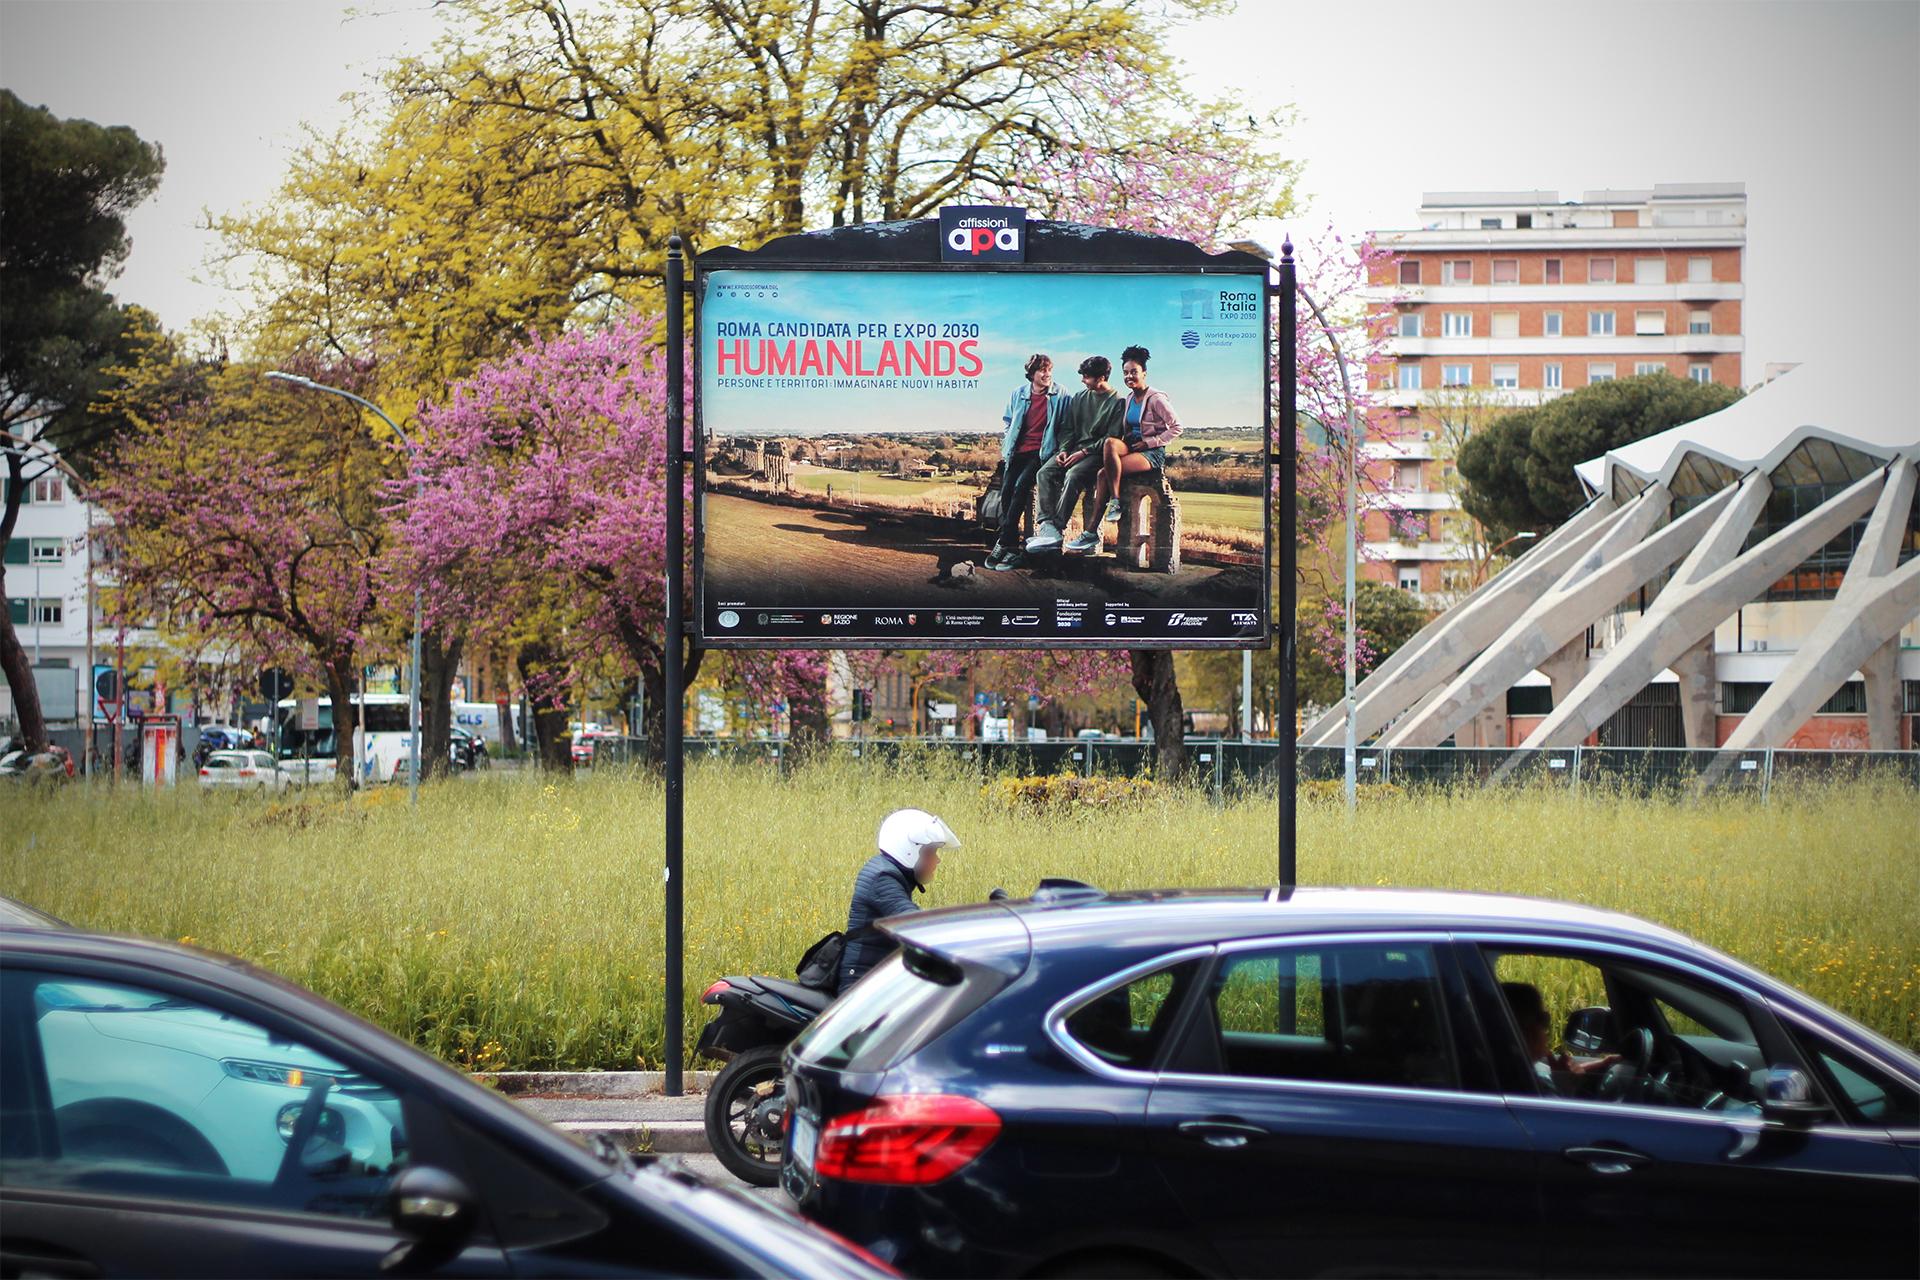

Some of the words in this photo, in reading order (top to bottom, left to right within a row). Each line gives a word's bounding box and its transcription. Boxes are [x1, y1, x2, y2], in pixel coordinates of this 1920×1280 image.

[959, 218, 1008, 228] affissioni
[948, 228, 1018, 256] apa
[1220, 291, 1256, 300] Roma
[1220, 301, 1256, 311] Italia
[718, 322, 762, 337] ROMA
[768, 323, 850, 337] CANDIDATA
[858, 324, 887, 338] PER
[895, 324, 936, 338] EXPO
[943, 324, 979, 338] 2030
[718, 339, 983, 377] HUMANLANDS
[718, 379, 764, 388] PERSONE
[768, 379, 772, 388] E
[834, 380, 897, 388] IMMAGINARE
[902, 380, 933, 388] NUOVI
[937, 380, 978, 388] HABITAT
[457, 714, 483, 725] GLS
